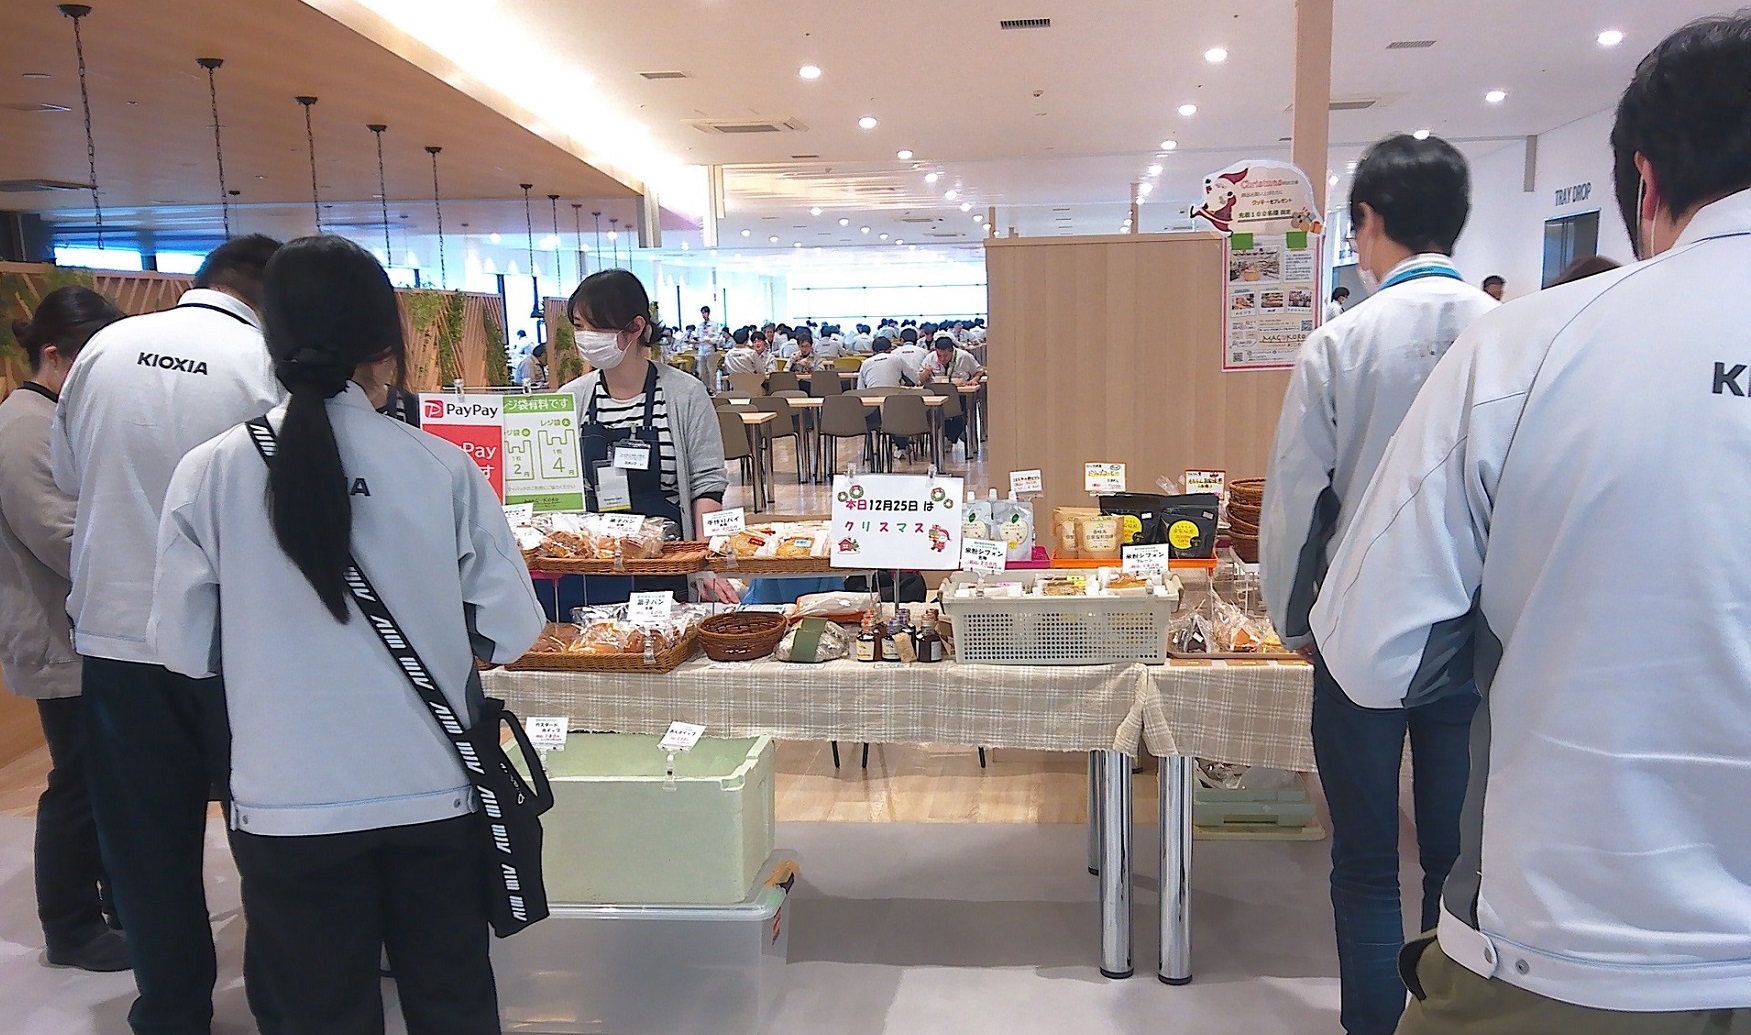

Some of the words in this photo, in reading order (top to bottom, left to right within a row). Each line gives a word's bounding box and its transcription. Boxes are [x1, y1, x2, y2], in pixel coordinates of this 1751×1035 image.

[1555, 187, 1572, 206] TRAY
[1572, 182, 1592, 203] DROP
[137, 352, 208, 376] KIOXIA
[1712, 361, 1751, 398] K
[446, 403, 498, 419] PayPay
[503, 398, 568, 411] ジ袋有料です
[540, 419, 561, 427] レジ袋
[504, 428, 520, 437] ジ袋
[461, 442, 497, 460] Pay
[513, 464, 523, 475] 2
[552, 457, 565, 473] 4
[845, 499, 918, 512] 本日12月25日
[923, 501, 935, 512] は
[707, 516, 740, 526] 手作りパイ
[844, 520, 925, 533] クリスマス
[1125, 552, 1165, 560] 米粉シフォン
